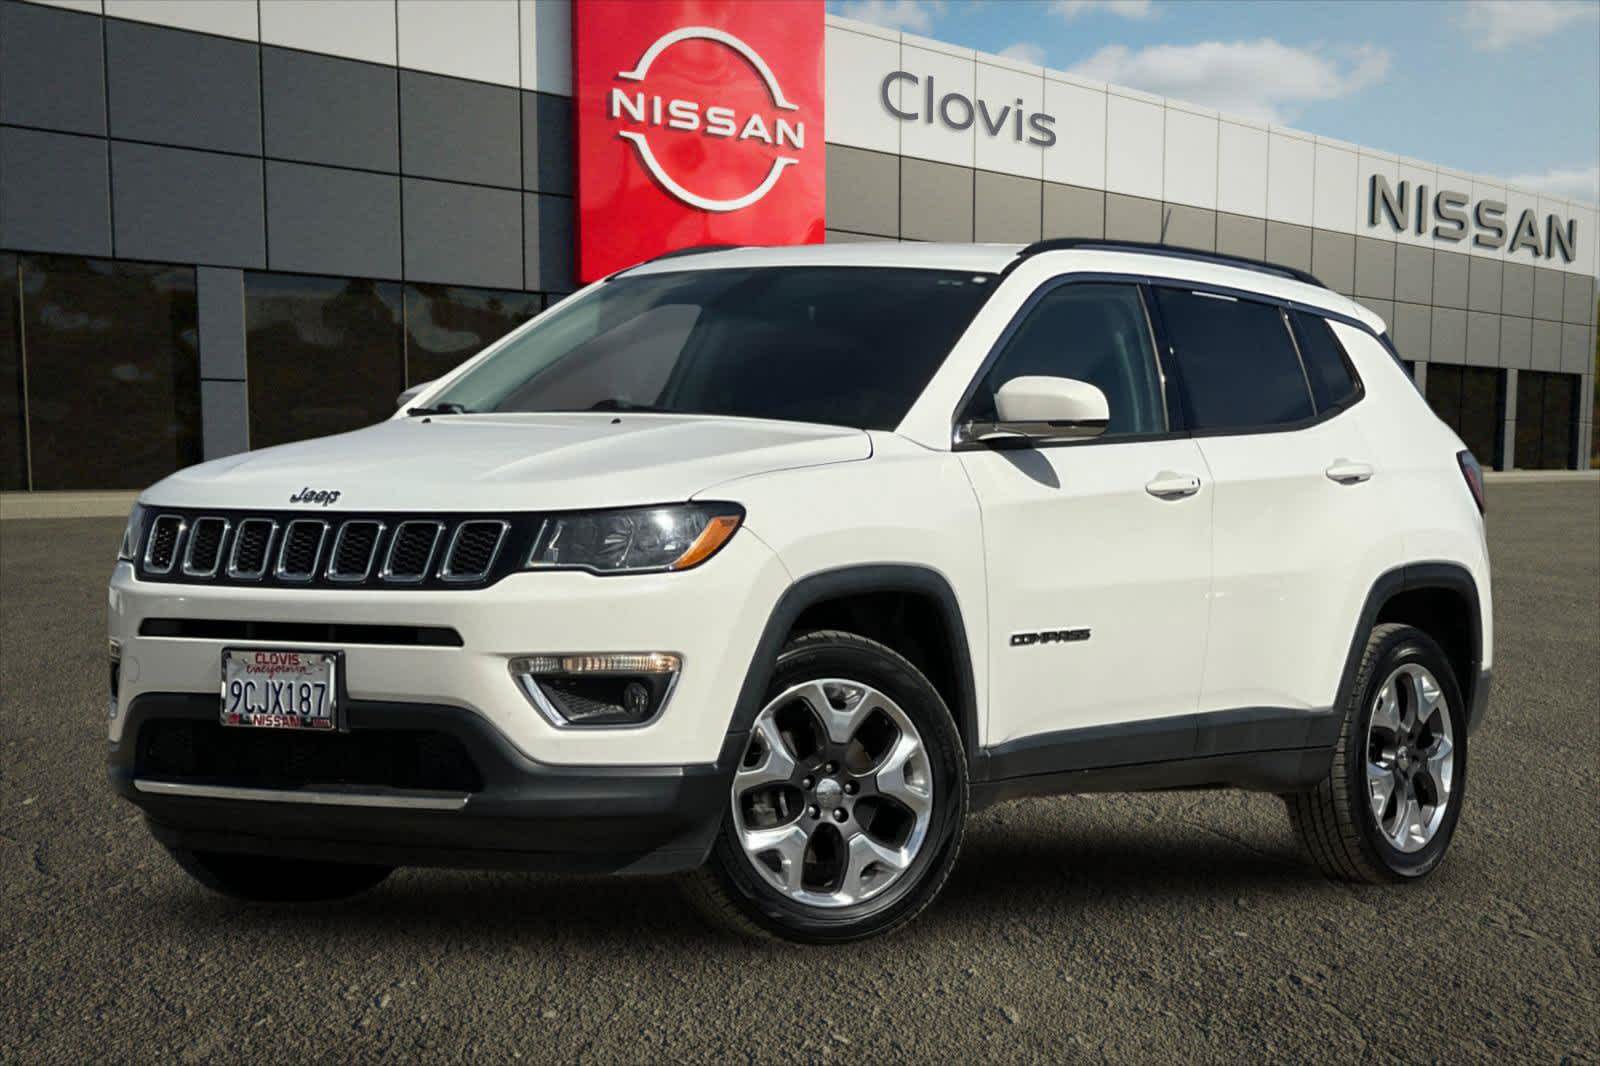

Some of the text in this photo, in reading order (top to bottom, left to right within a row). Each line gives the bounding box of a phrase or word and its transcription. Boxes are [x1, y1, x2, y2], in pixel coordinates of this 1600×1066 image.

[611, 87, 805, 150] NISSAN
[881, 70, 1057, 147] Clovis
[1368, 173, 1578, 263] NISSAN
[289, 486, 341, 507] Jeep
[254, 652, 301, 665] CLOVIS
[230, 680, 327, 716] 9CJX187
[251, 714, 300, 728] NISSAN
